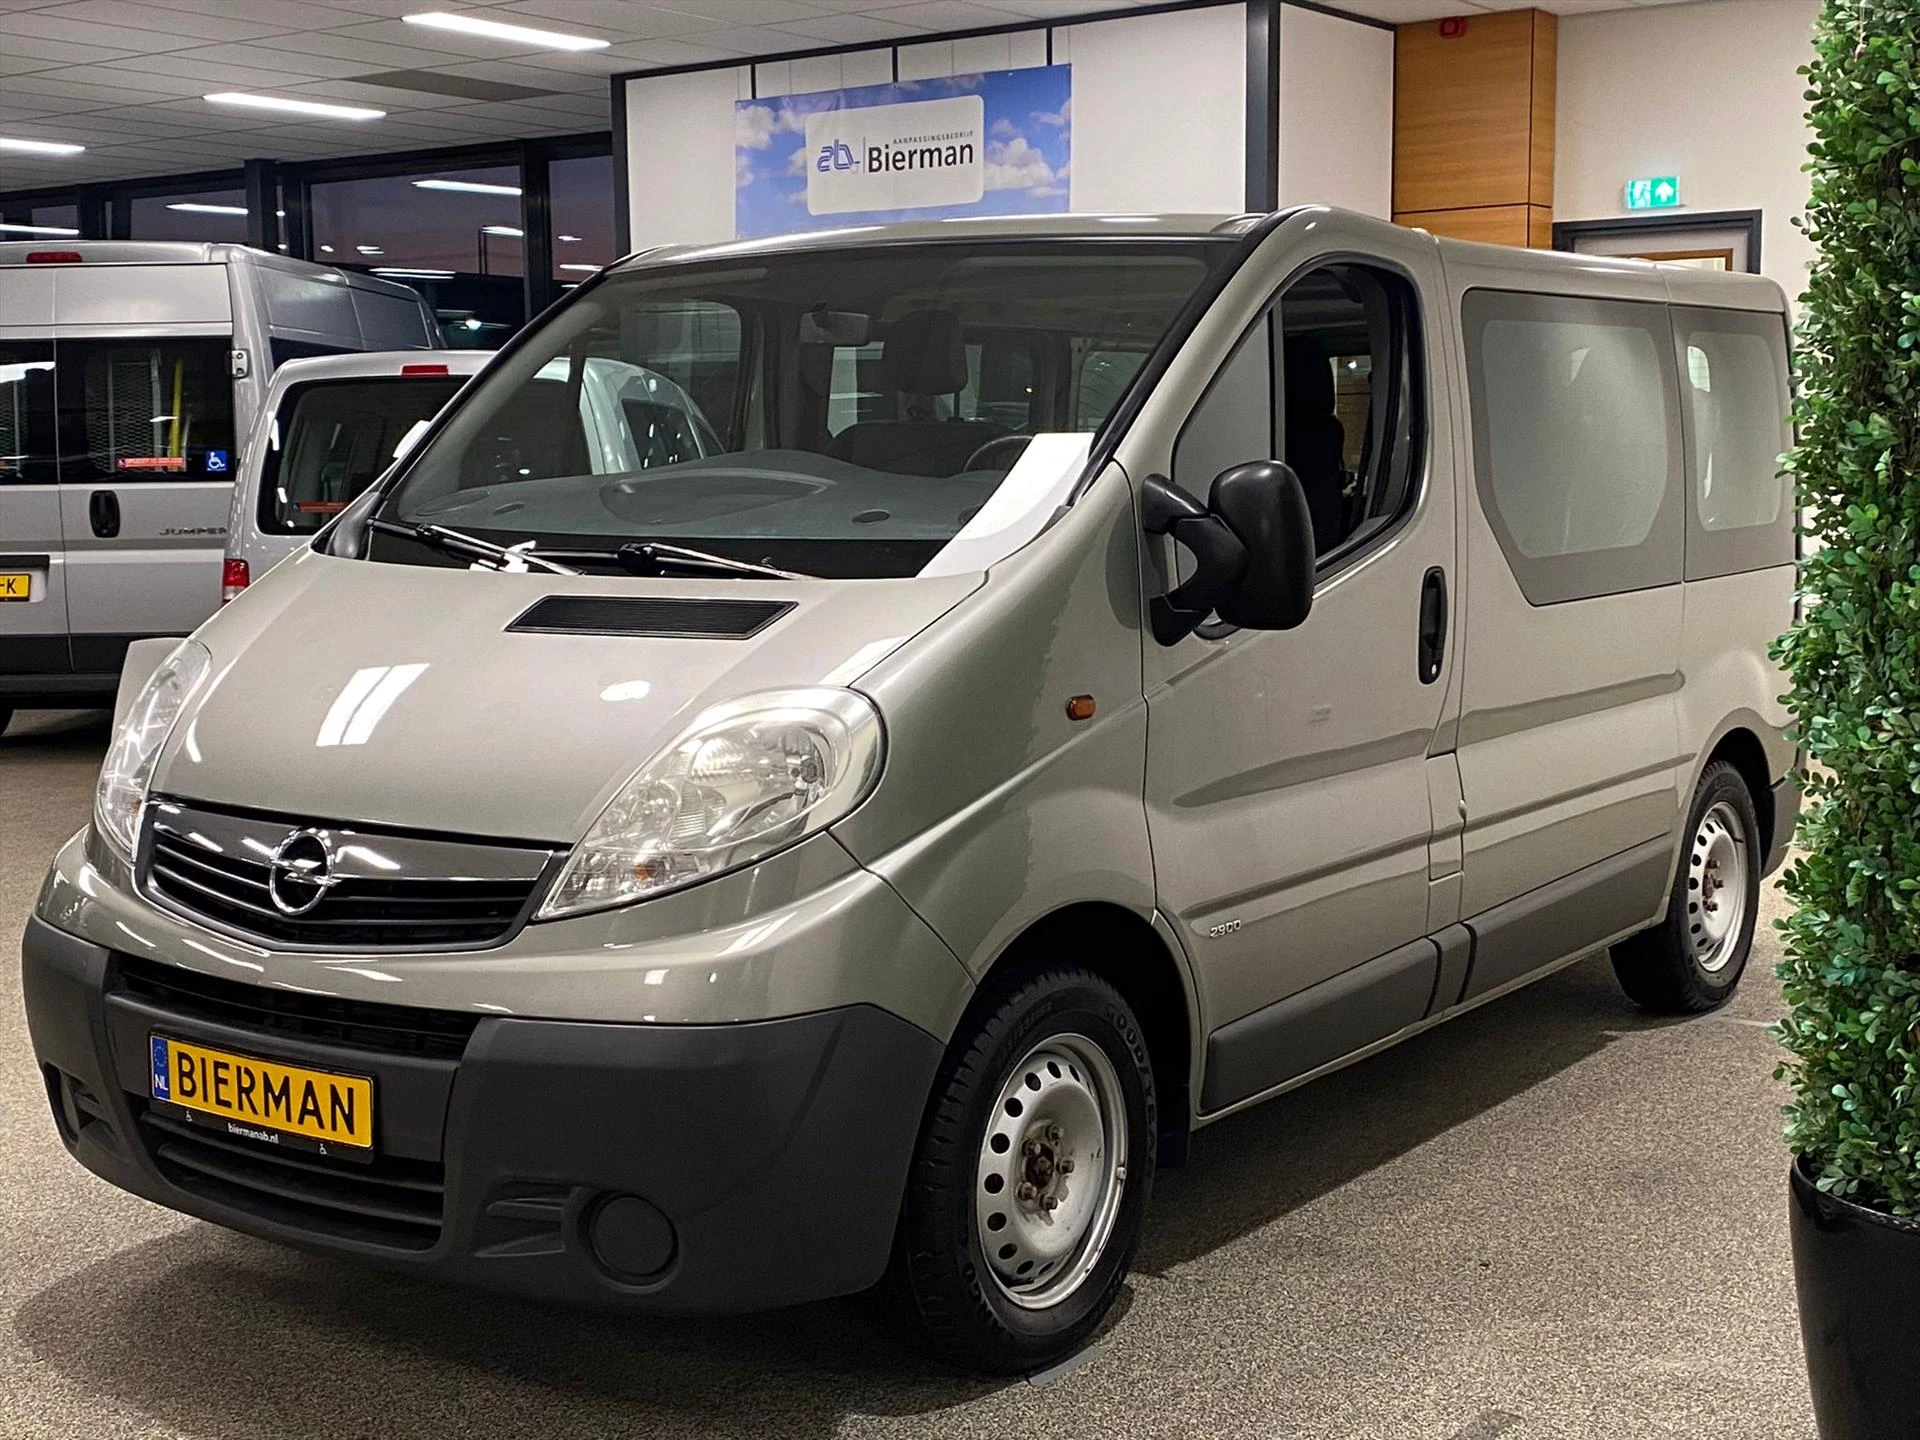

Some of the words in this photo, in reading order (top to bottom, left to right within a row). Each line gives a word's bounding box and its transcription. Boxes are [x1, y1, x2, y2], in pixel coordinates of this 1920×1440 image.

[892, 130, 974, 145] AANPASSINGSBEDRIJF
[868, 143, 974, 173] Bierman
[159, 527, 228, 536] JUMPER
[1209, 919, 1242, 938] 2900
[154, 1073, 169, 1091] NL
[177, 1051, 355, 1136] BIERMAN
[228, 1122, 279, 1145] biermanab.nl
